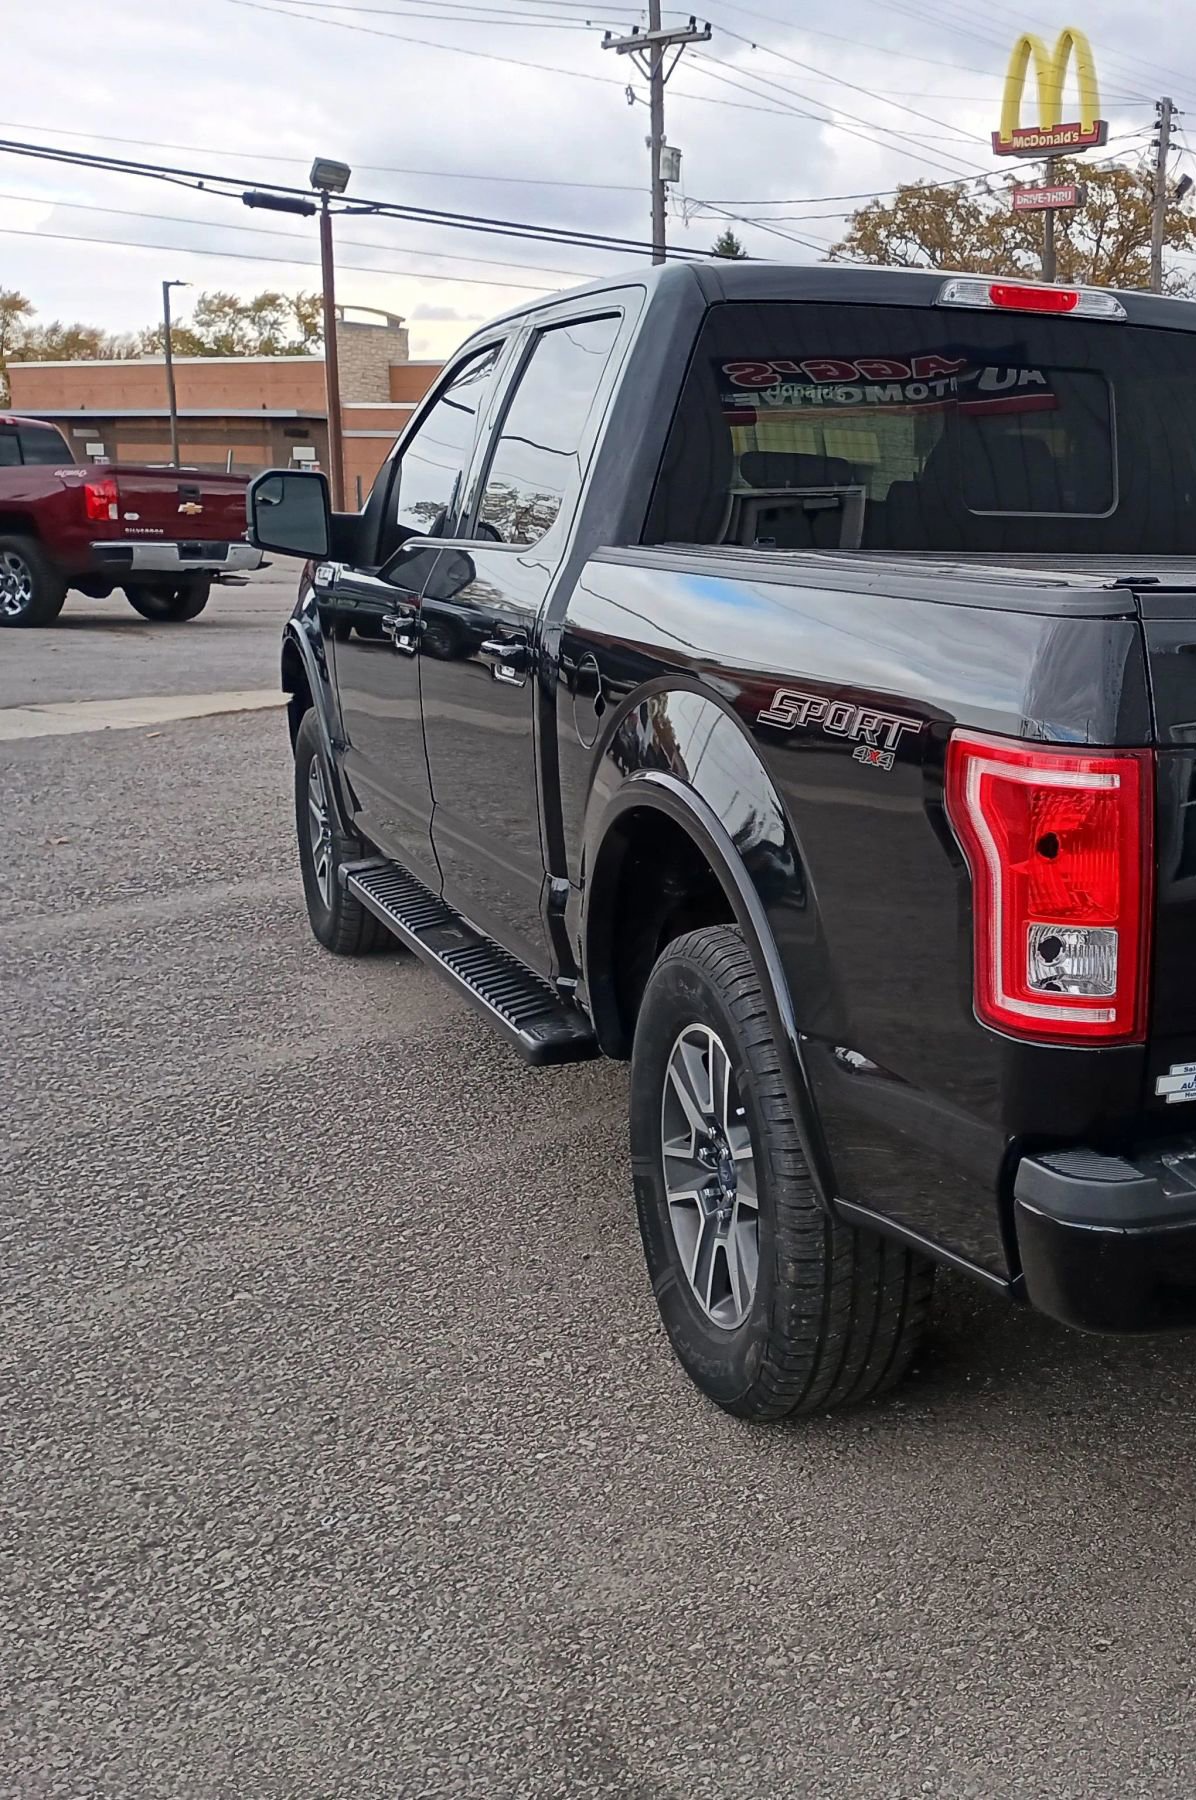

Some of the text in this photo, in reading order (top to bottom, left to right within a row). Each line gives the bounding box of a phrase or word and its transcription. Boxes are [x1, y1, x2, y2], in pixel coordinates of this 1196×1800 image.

[1013, 131, 1079, 149] McDonald's
[1016, 190, 1072, 205] DRIVE-THRU
[756, 687, 924, 751] SPORT
